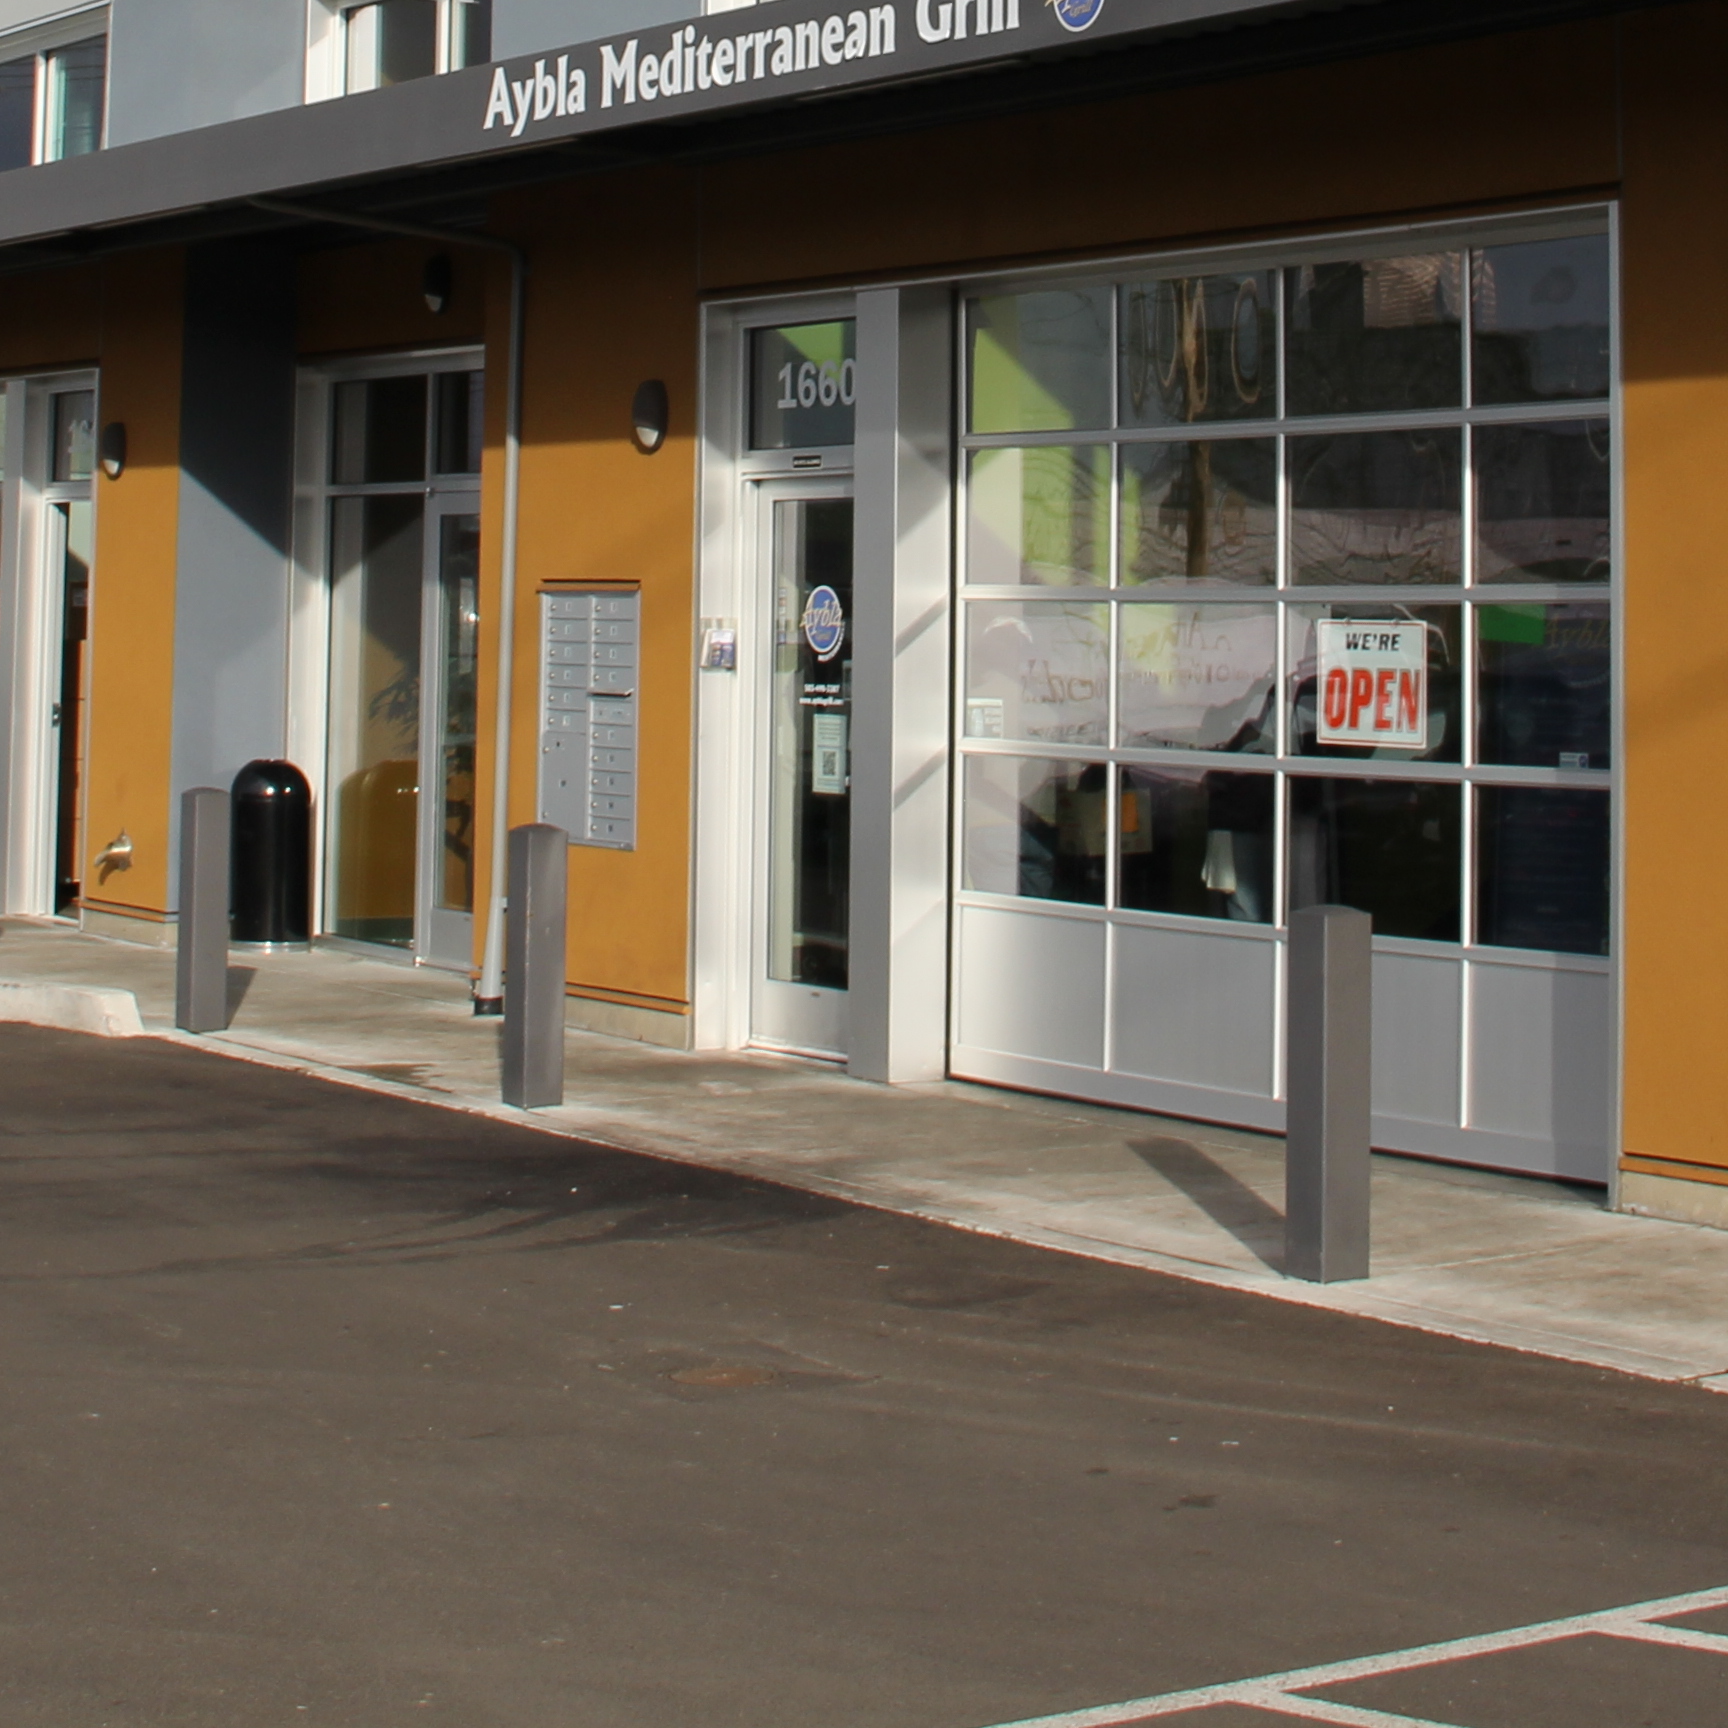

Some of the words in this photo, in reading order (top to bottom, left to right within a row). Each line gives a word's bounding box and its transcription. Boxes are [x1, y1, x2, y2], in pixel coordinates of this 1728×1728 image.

[482, 66, 587, 137] Aybla
[599, 3, 896, 109] Mediterranean
[777, 358, 856, 409] 1660
[1345, 633, 1401, 651] WE'RE
[1324, 666, 1422, 734] OPEN
